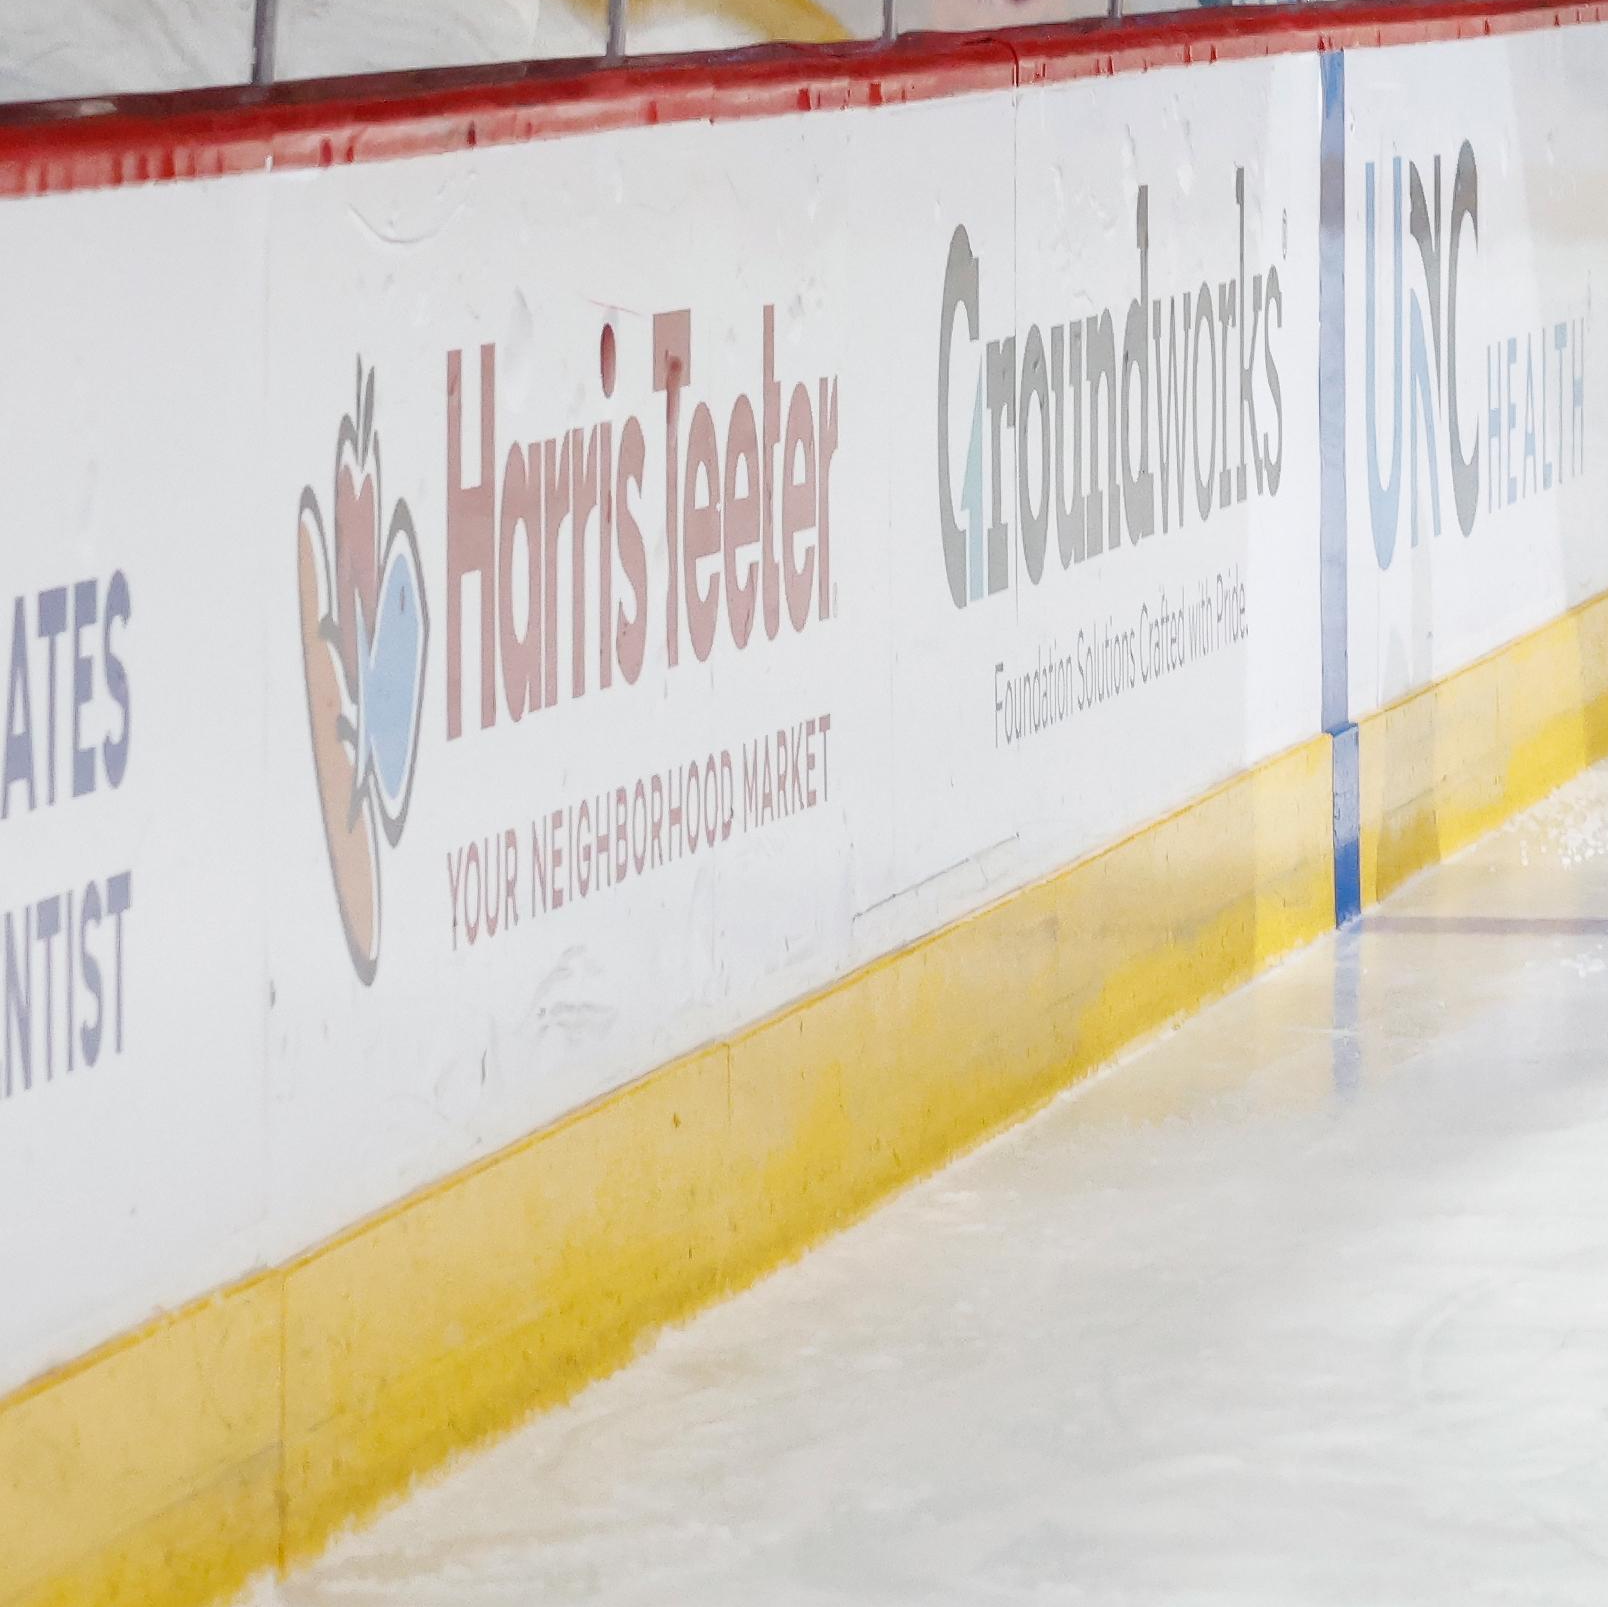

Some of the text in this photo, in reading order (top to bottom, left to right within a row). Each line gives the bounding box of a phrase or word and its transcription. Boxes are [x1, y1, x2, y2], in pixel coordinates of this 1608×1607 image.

[938, 166, 1283, 610] Groundworks
[1365, 139, 1479, 571] UNC
[1487, 317, 1585, 514] HEALTH
[447, 304, 839, 742] Harris Teeter
[0, 569, 131, 820] ATES
[994, 563, 1249, 748] Foundation Solutions Crafted with Pride.
[447, 714, 832, 952] YOUR NEIGHBORHOOD MARKET
[3, 870, 132, 1095] NTIST
